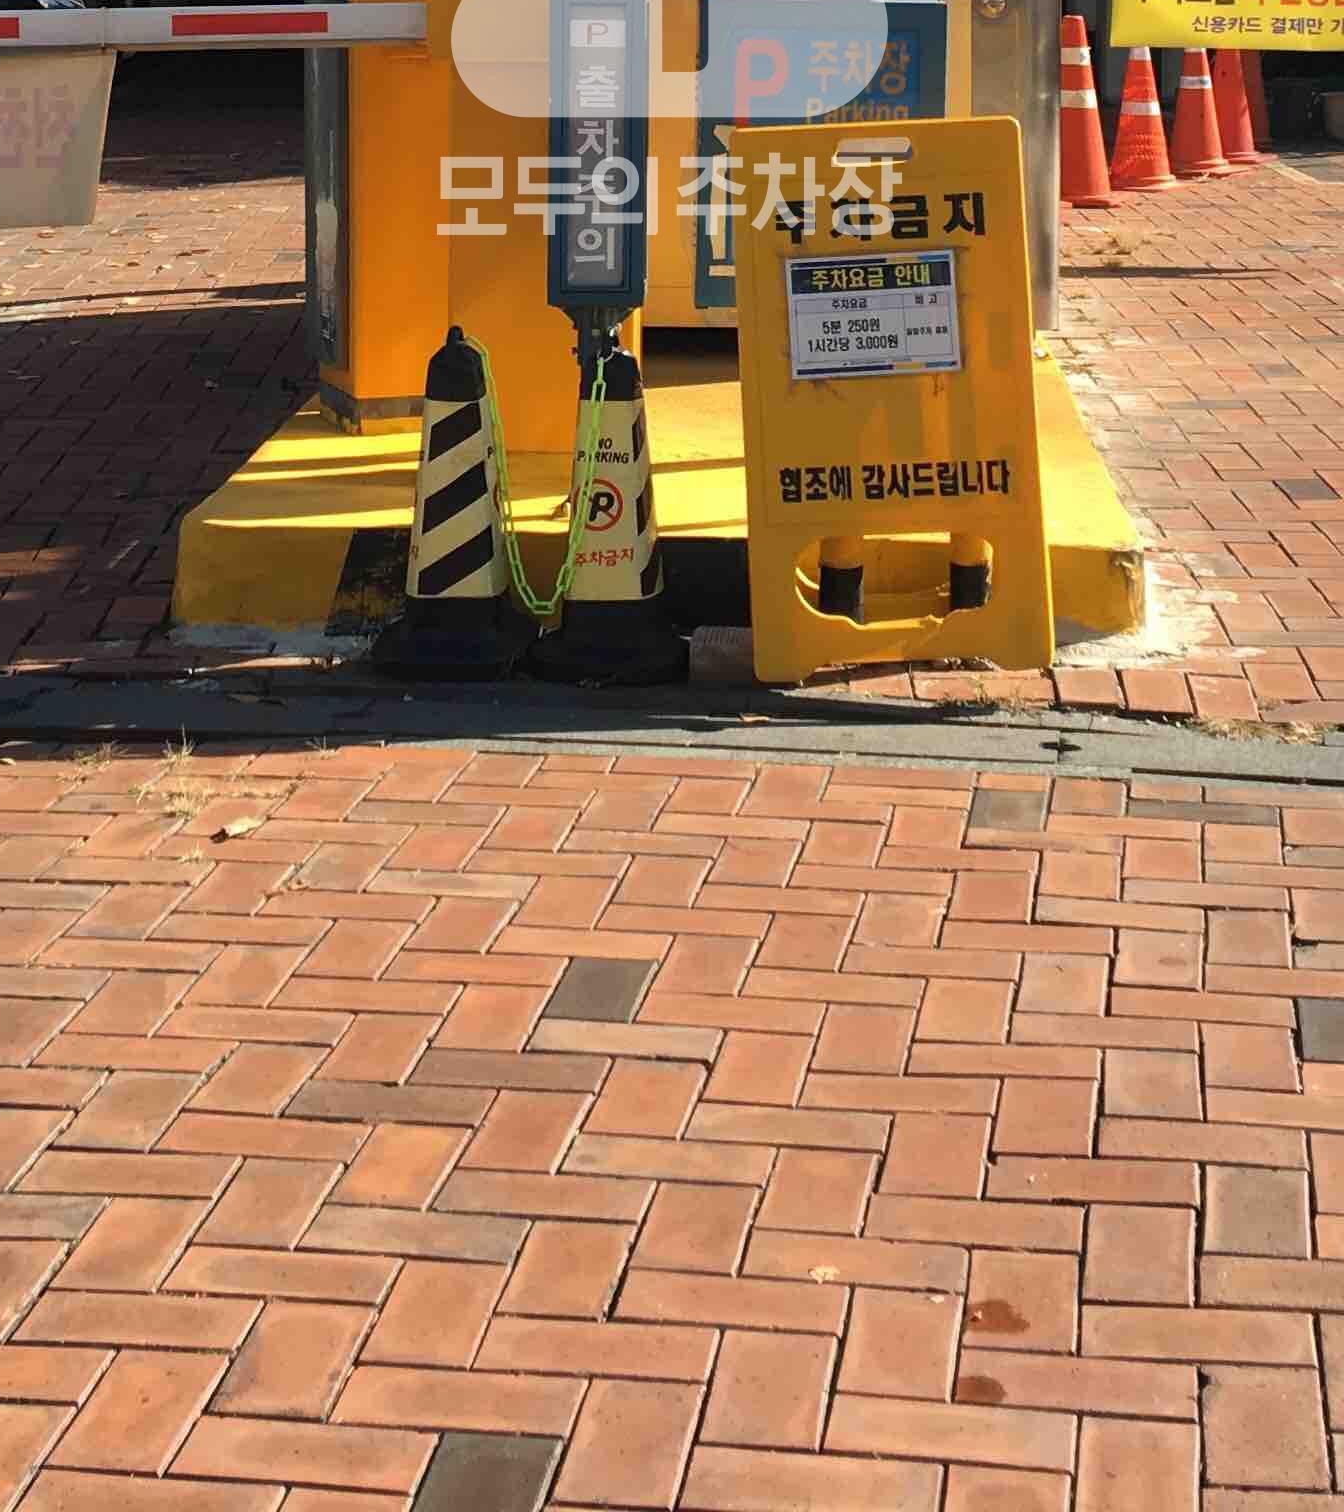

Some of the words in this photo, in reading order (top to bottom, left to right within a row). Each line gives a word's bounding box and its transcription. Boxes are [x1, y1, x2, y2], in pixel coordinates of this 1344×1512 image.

[586, 21, 610, 46] P
[1192, 15, 1263, 33] 신용카드
[1270, 16, 1323, 35] 결제만
[810, 266, 885, 291] 주차요금
[894, 263, 931, 286] 안내
[847, 317, 882, 334] 250원
[807, 337, 851, 354] 1시간당
[576, 449, 630, 465] PRKING
[779, 465, 853, 503] 협조에
[861, 459, 1011, 500] 감사드립니다
[574, 547, 635, 568] 주차금지
